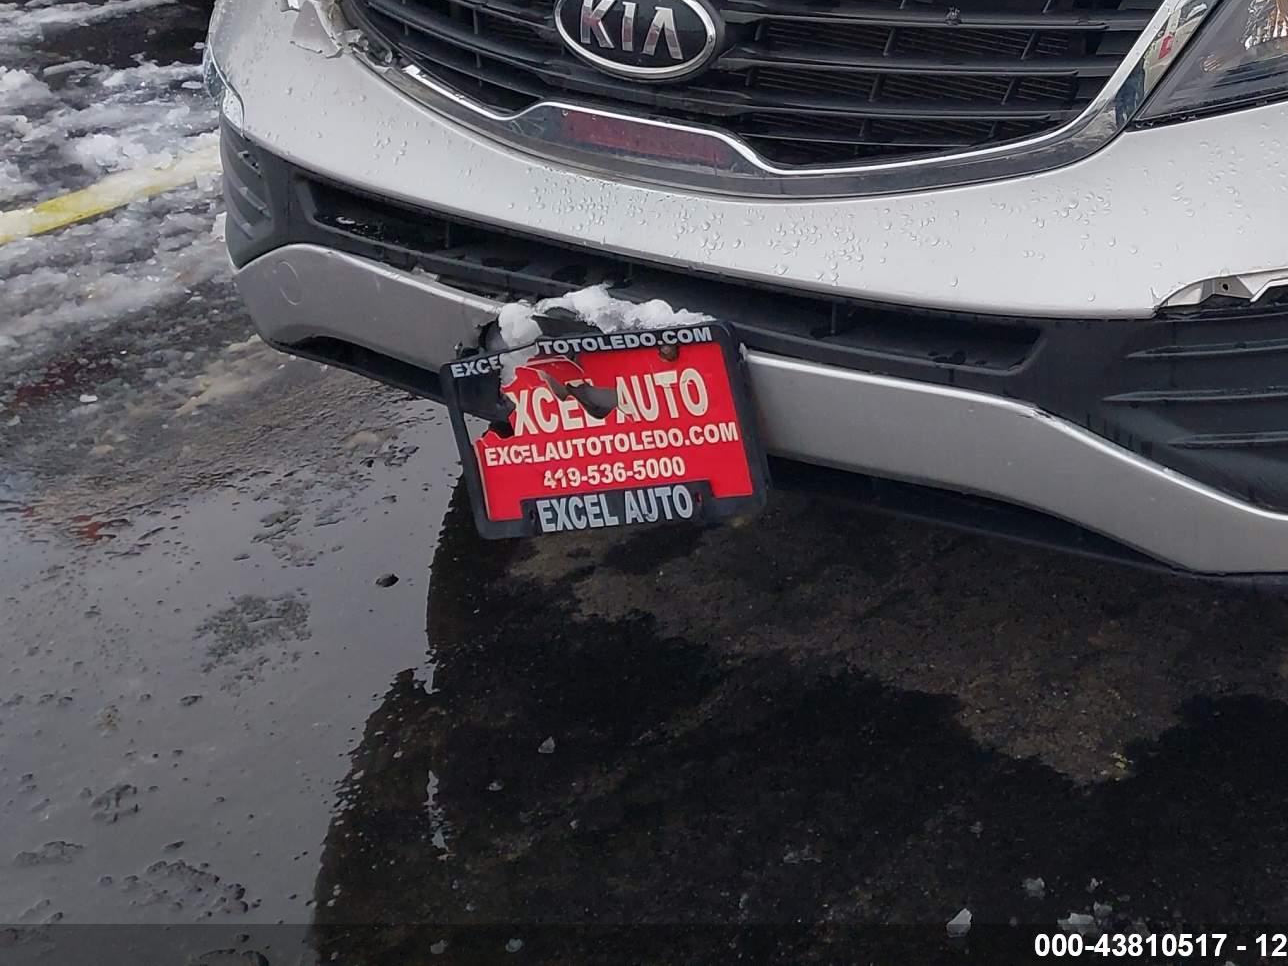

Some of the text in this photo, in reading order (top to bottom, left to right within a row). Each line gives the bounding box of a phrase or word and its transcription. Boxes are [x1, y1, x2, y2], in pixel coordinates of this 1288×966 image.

[451, 327, 712, 378] EXCETOTOLEDO.COM
[503, 368, 709, 438] XCE AUTO
[485, 422, 739, 467] EXCELAUTOTOLEDO.COM
[543, 456, 686, 489] 419-536-5000
[536, 485, 693, 533] EXCEL AUTO
